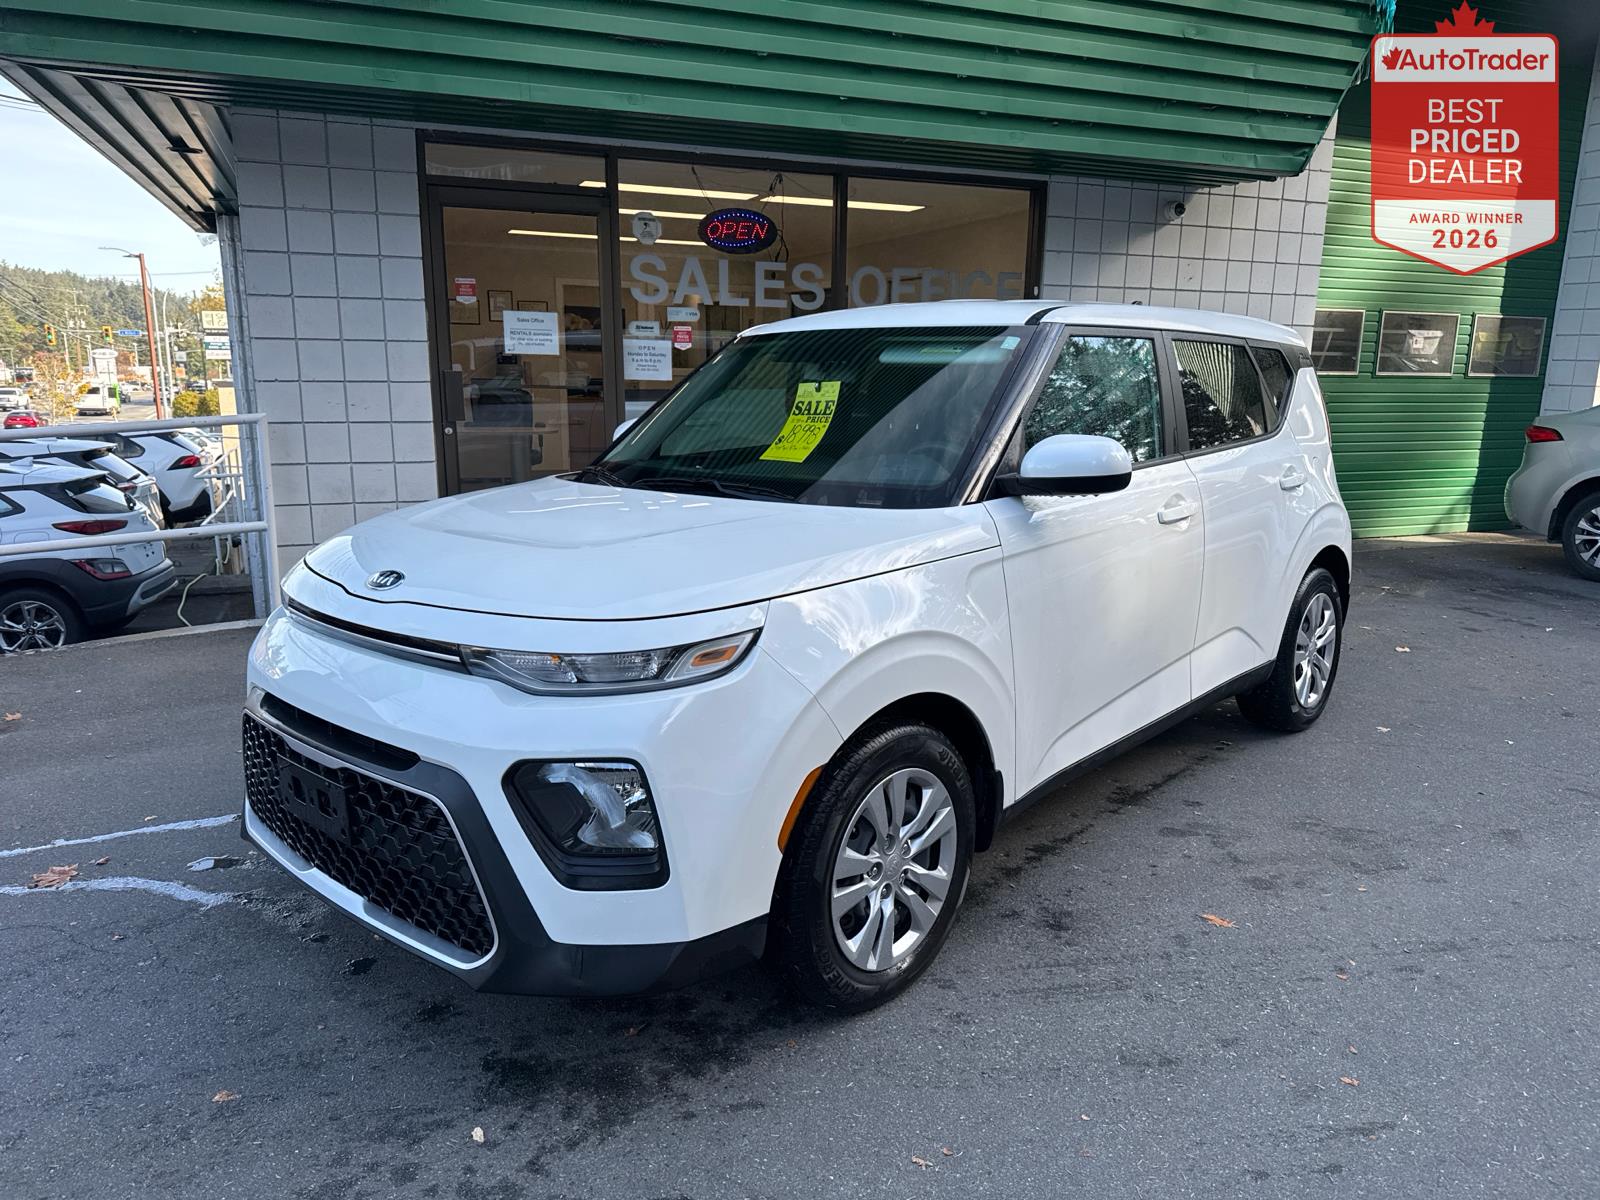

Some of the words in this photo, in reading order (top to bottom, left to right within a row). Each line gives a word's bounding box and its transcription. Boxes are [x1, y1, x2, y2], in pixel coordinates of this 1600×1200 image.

[706, 221, 769, 239] OPEN
[629, 254, 826, 311] SALES
[851, 265, 1023, 308] OFFICE
[792, 400, 836, 416] SALE
[805, 415, 832, 424] PRICE
